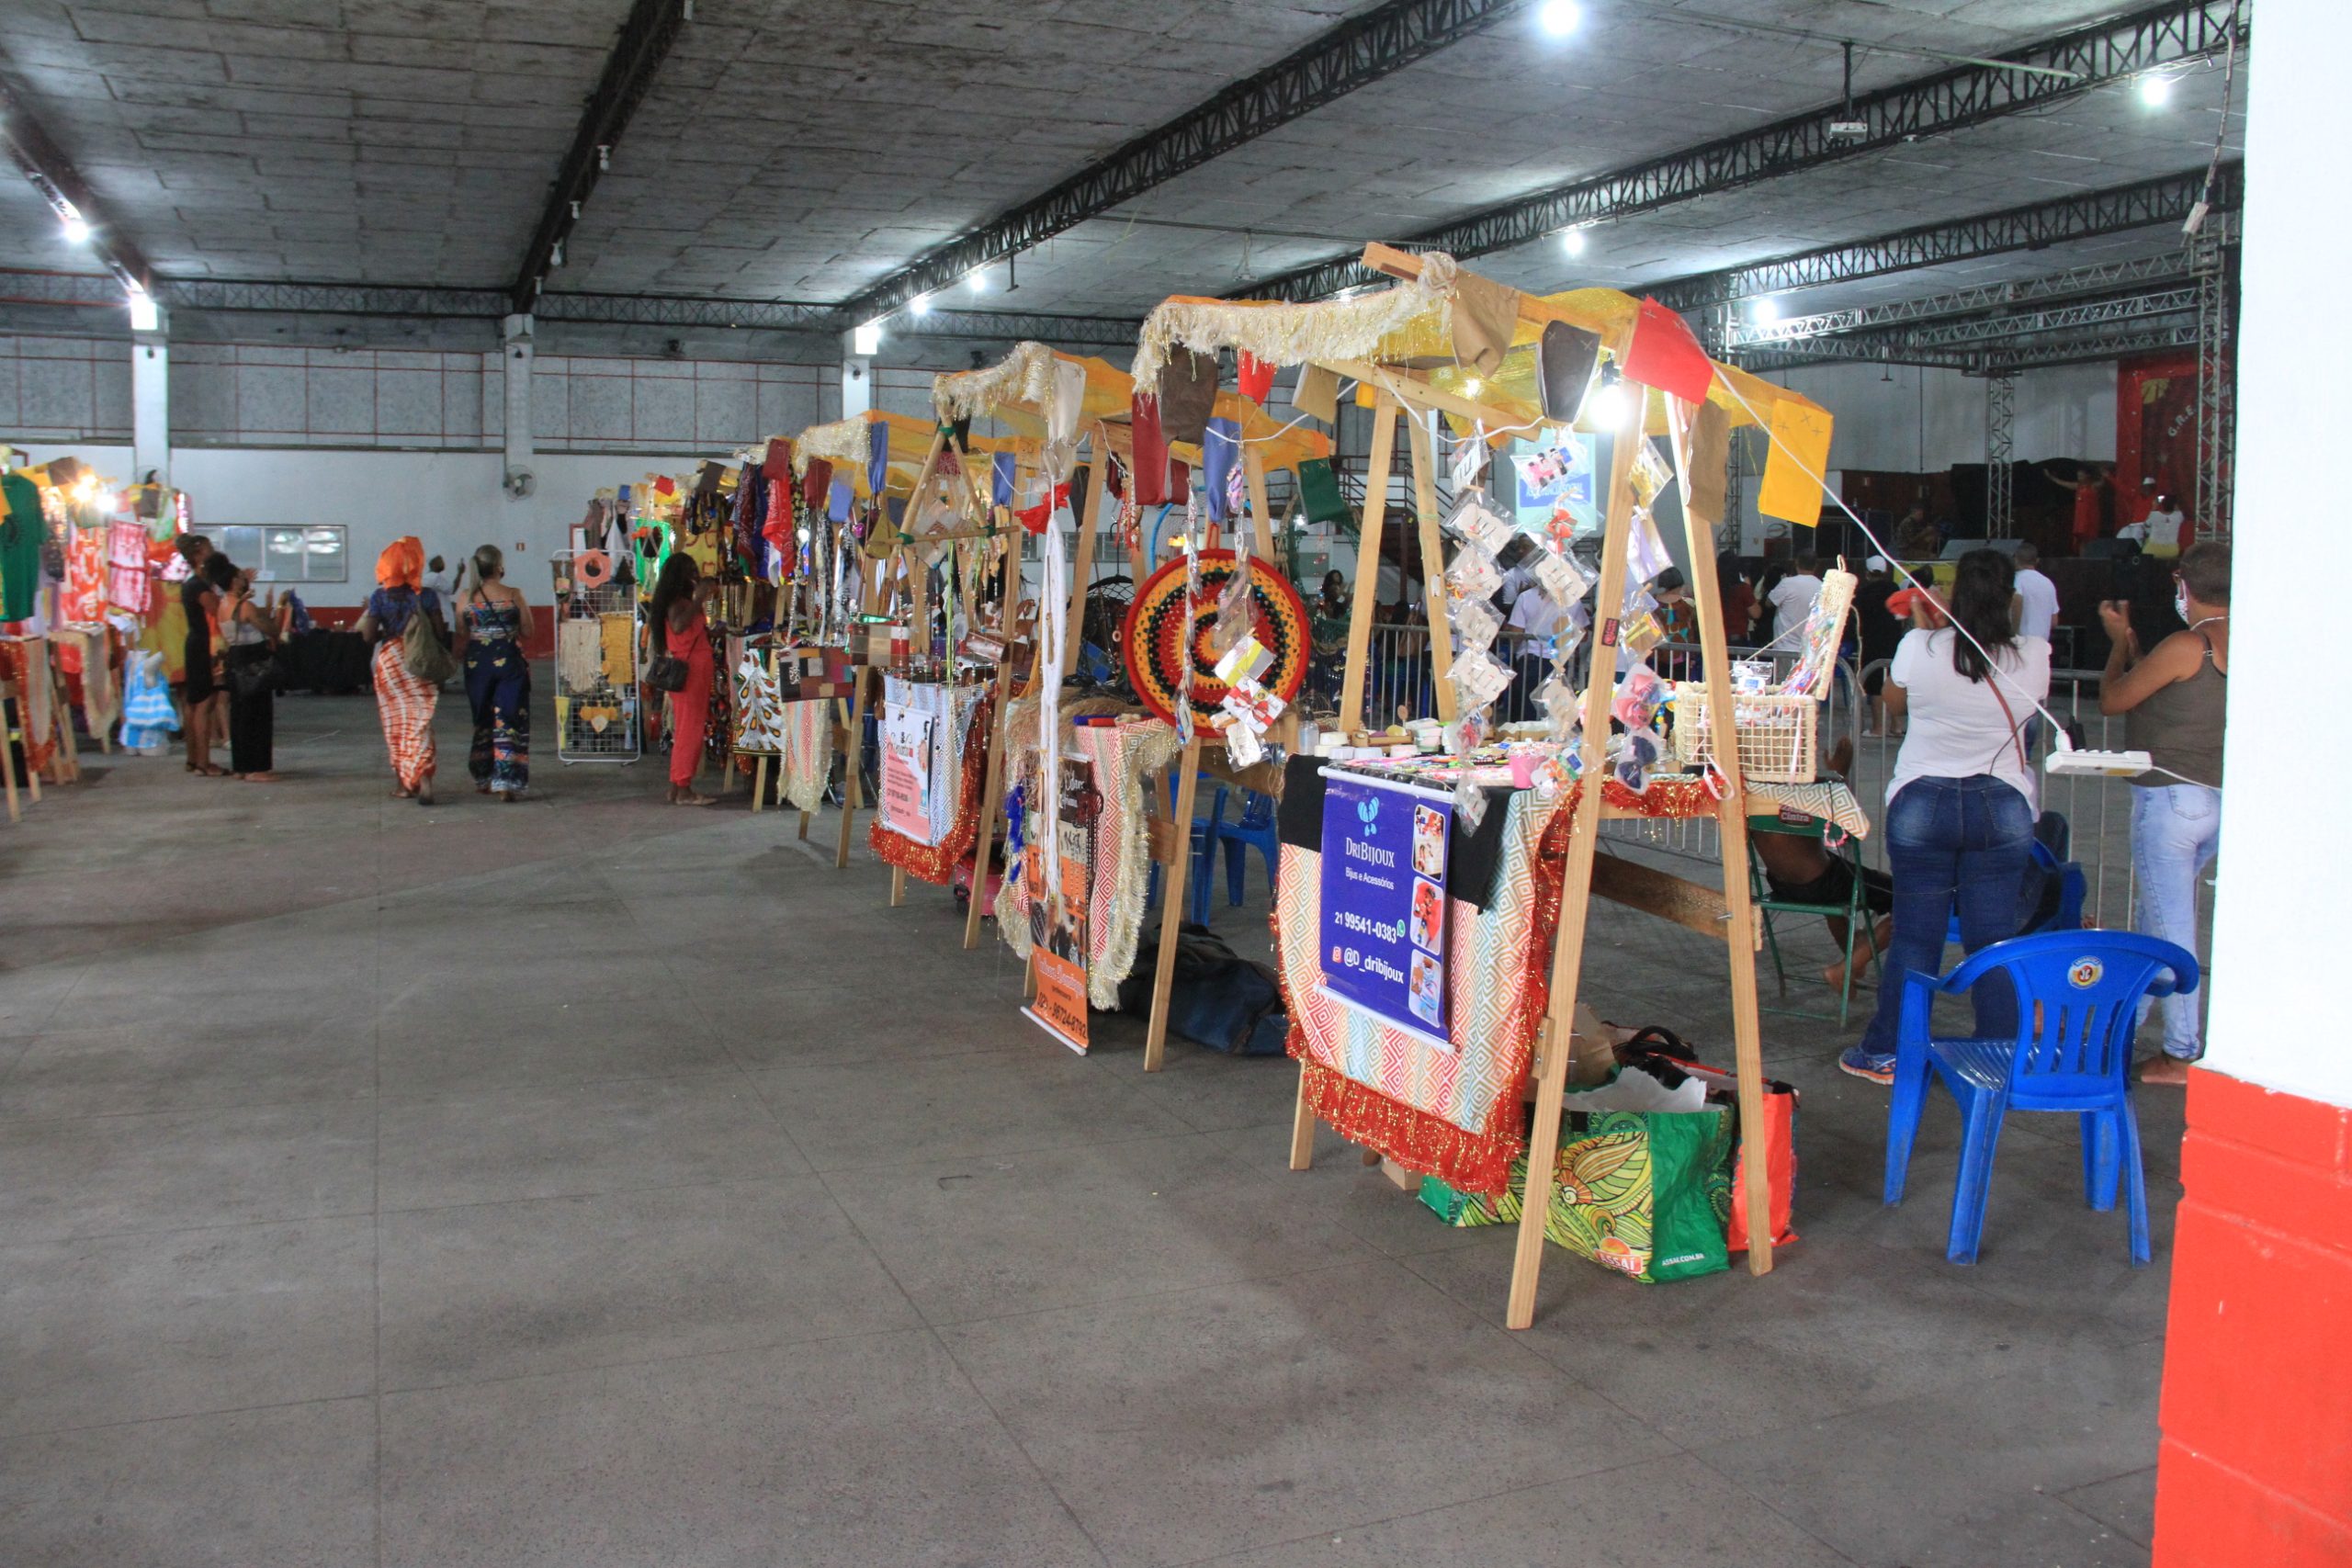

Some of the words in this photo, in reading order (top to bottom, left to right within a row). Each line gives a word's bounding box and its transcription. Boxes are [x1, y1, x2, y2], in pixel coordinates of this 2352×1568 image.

[1345, 866, 1358, 881] Bijus
[1358, 874, 1363, 882] e
[1363, 872, 1395, 890] Acessórios
[1334, 911, 1343, 926] 21
[1344, 911, 1397, 944] 99541-0383
[1343, 947, 1405, 985] @D_dribijoux
